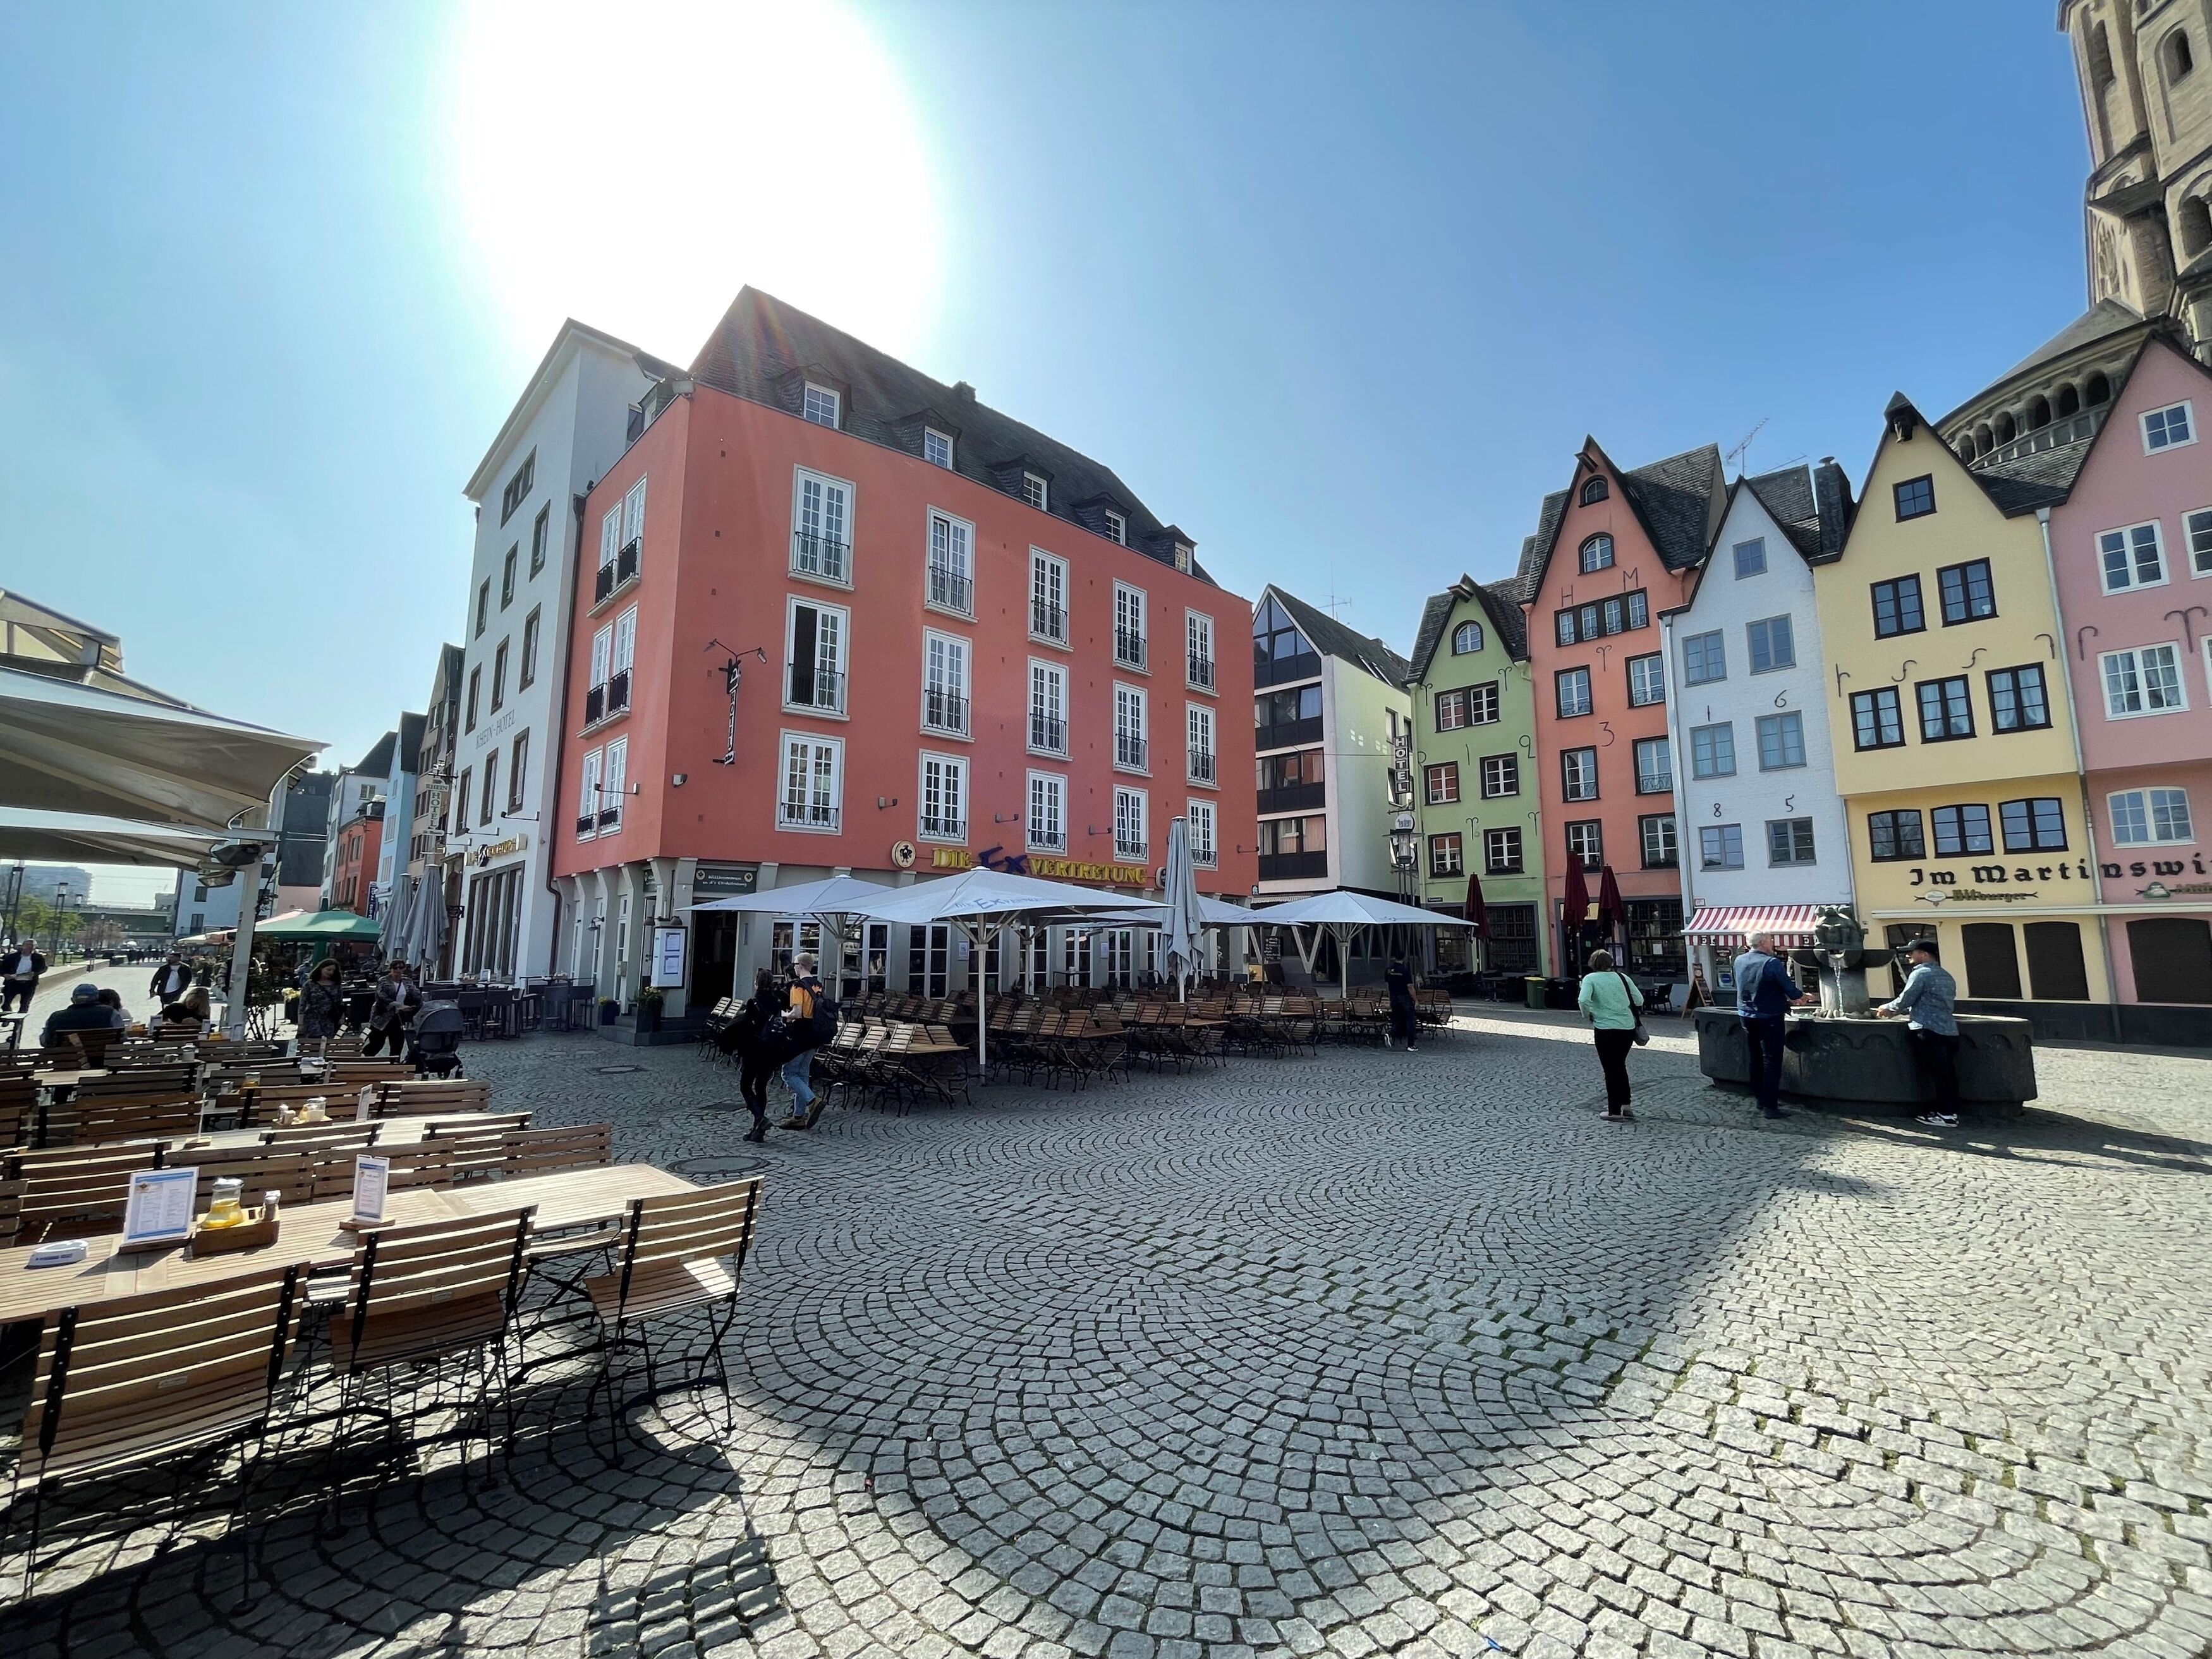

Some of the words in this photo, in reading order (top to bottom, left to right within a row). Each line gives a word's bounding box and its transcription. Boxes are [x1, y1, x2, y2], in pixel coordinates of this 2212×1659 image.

[1395, 736, 1407, 793] HOTEL
[430, 791, 441, 827] HOTEL
[932, 848, 973, 869] DIE
[1028, 857, 1147, 884] VERTRETUNG
[1970, 852, 2212, 884] Martinswi
